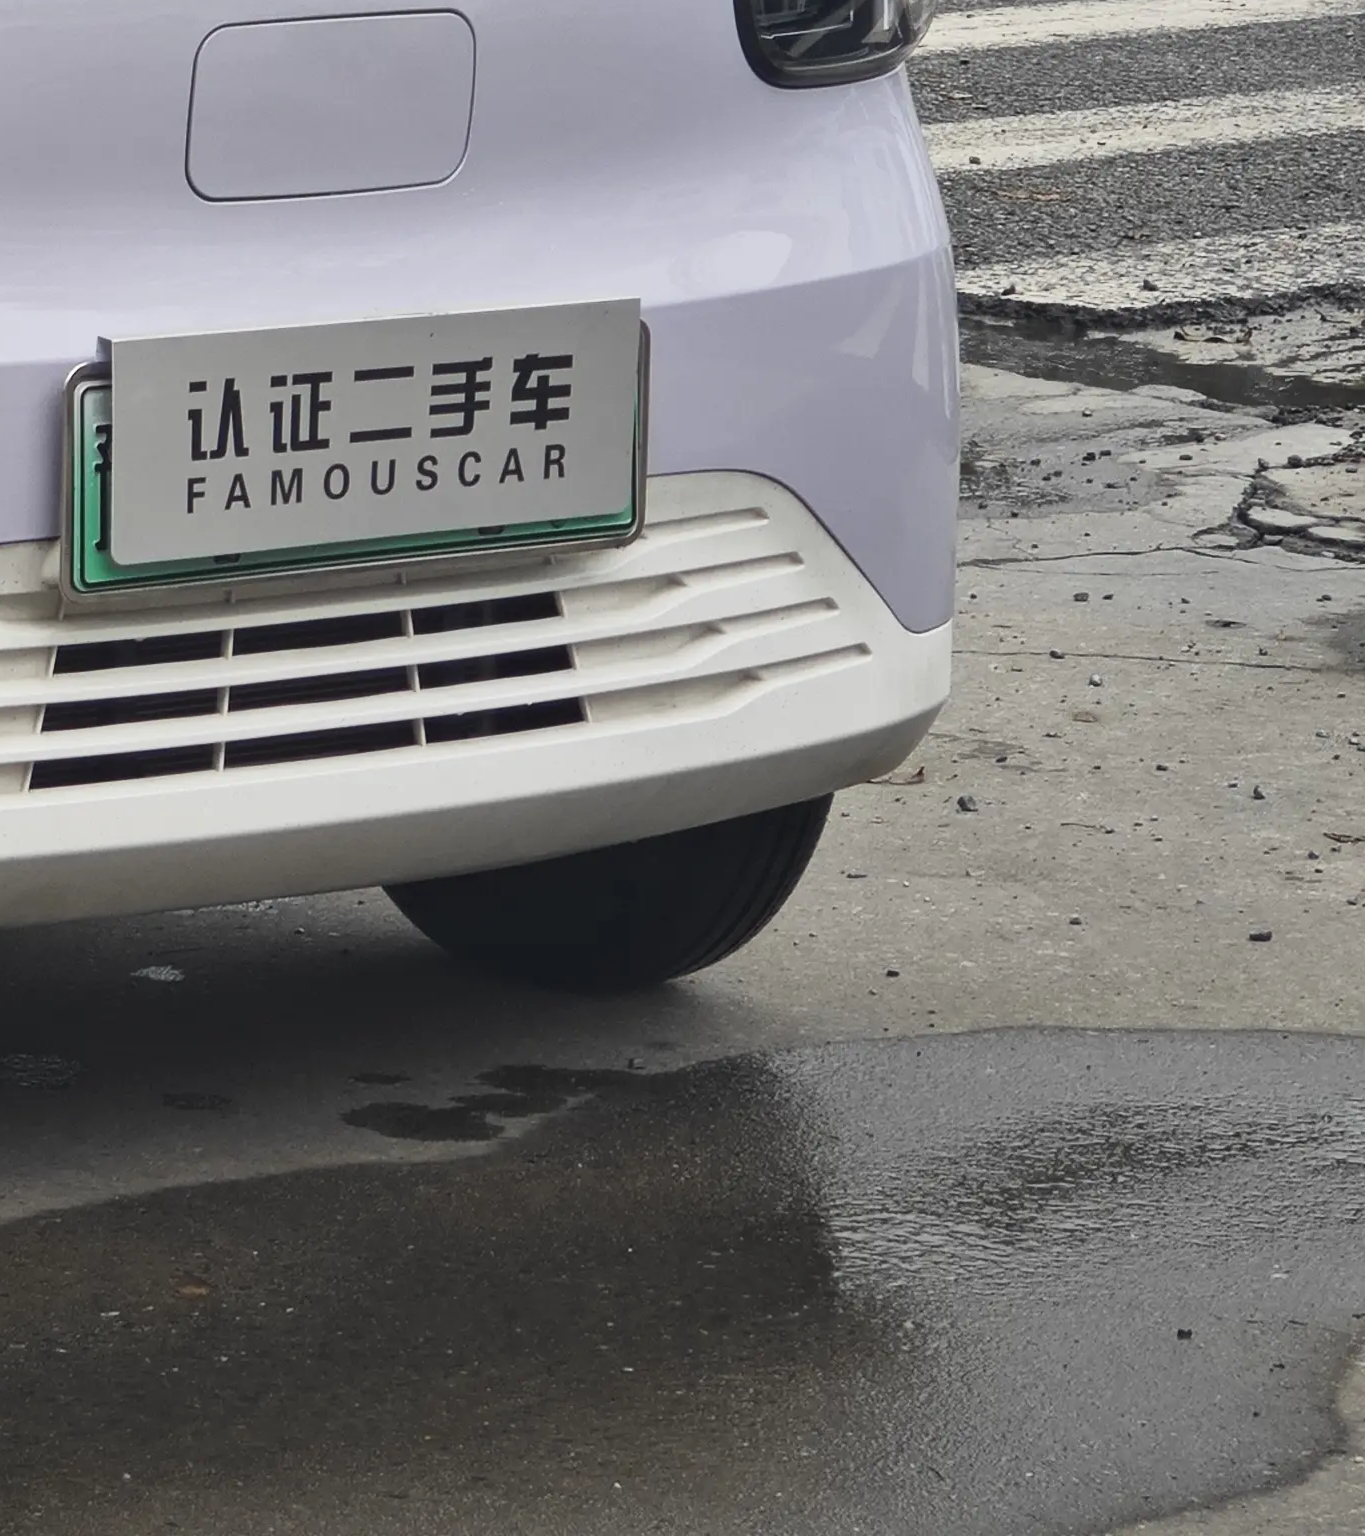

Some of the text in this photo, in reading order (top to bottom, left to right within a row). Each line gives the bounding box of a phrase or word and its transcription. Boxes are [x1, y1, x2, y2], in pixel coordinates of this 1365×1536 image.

[186, 353, 574, 461] 认证二手车
[185, 444, 567, 514] FAMOUSCAR
